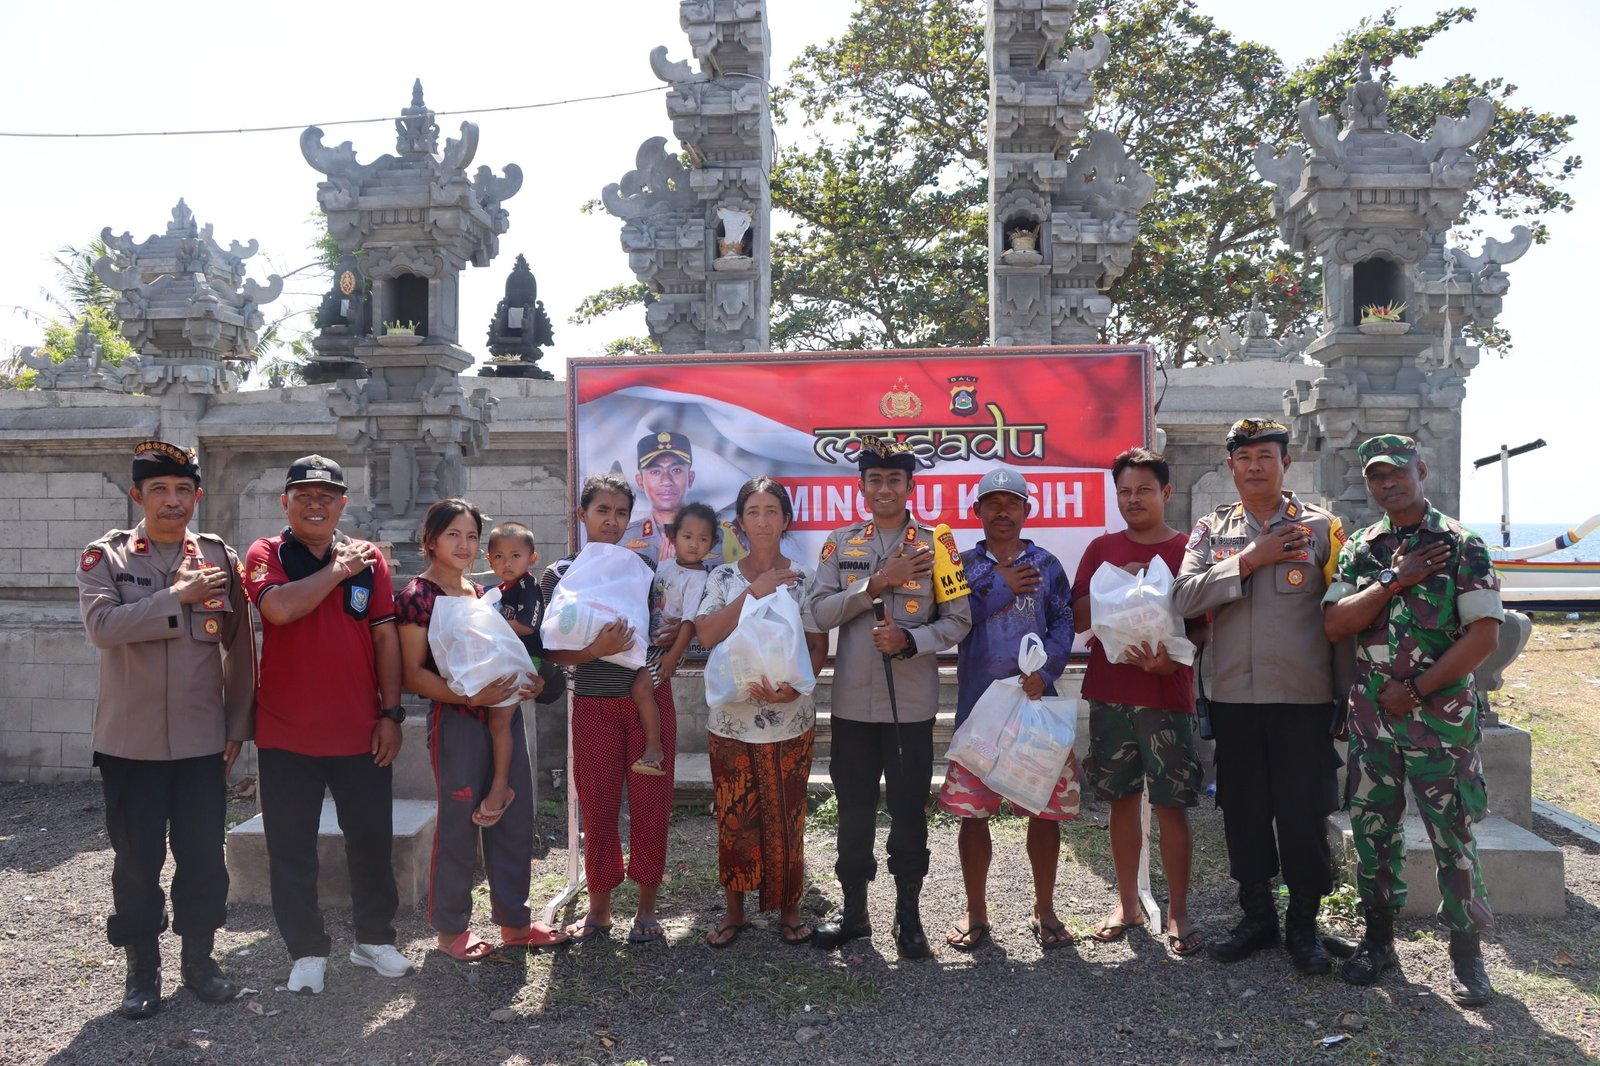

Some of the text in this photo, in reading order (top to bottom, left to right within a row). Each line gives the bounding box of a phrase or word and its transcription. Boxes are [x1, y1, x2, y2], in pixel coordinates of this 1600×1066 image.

[813, 402, 1047, 468] msadu
[784, 484, 943, 522] MINU
[941, 574, 954, 589] KA
